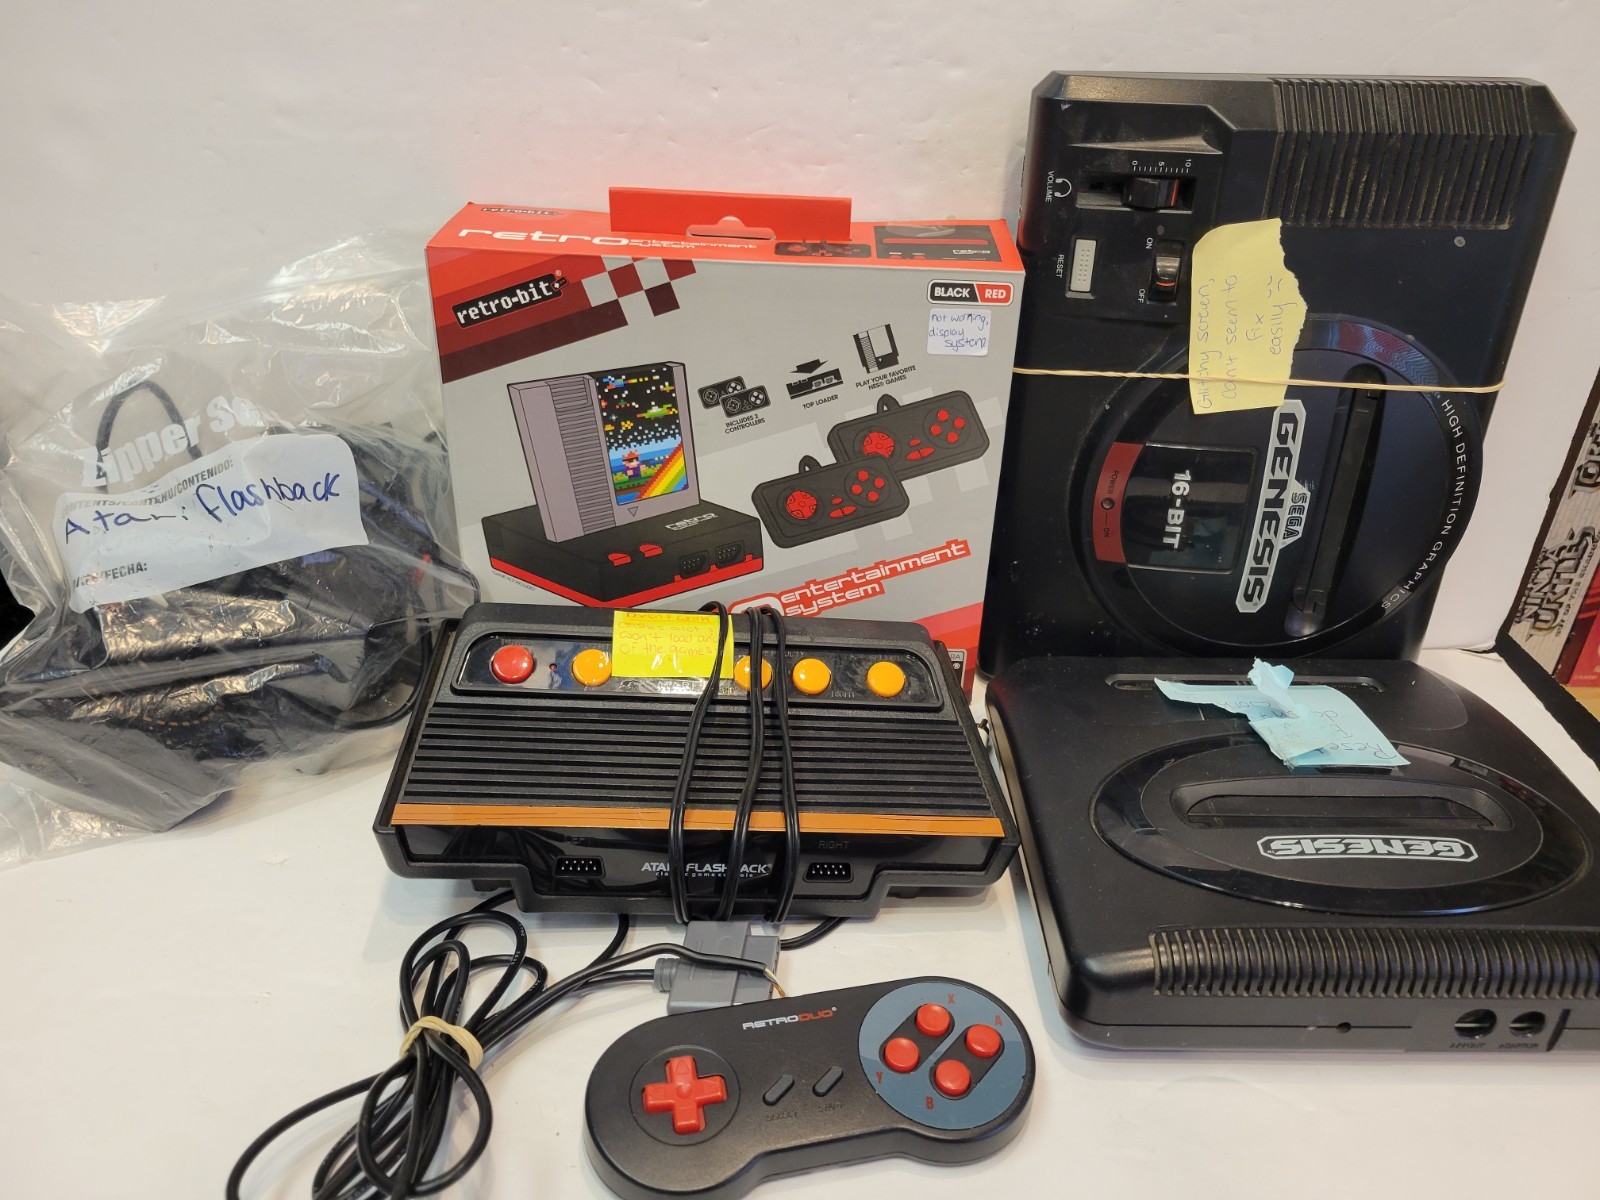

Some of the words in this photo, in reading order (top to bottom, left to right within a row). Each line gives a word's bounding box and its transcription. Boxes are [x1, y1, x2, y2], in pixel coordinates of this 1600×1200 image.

[1184, 158, 1192, 168] 10
[1045, 170, 1055, 203] VOLUME
[458, 228, 630, 247] retro
[1145, 237, 1154, 250] ON
[1055, 254, 1065, 279] RESET
[934, 286, 970, 298] BLACK
[984, 288, 1007, 299] RED
[1220, 274, 1238, 293] to
[456, 280, 553, 325] retro-bit
[1137, 288, 1146, 304] OFF
[931, 313, 947, 323] not
[1225, 299, 1238, 345] seem
[928, 326, 965, 339] display
[855, 378, 871, 388] PLAY
[871, 374, 888, 384] YOUR
[888, 365, 917, 379] FAVORITE
[885, 374, 907, 386] GAMES
[802, 402, 815, 410] TOP
[815, 394, 839, 407] LOADER
[725, 416, 754, 428] INCLUDES
[725, 417, 766, 434] CONTROLLERS
[1441, 399, 1464, 438] HIGH
[81, 415, 201, 489] Zipper
[1107, 469, 1120, 495] POWER
[1440, 442, 1467, 536] DEFINITION
[1162, 469, 1192, 549] 16-BIT
[1243, 412, 1299, 603] GENESIS
[1282, 492, 1308, 540] SEGA
[1103, 527, 1111, 538] ON
[780, 543, 966, 604] entertainment
[1381, 541, 1444, 610] GRAPHICS
[785, 582, 880, 616] system
[818, 840, 849, 849] RIGHT
[1269, 838, 1466, 857] GENESIS
[641, 862, 670, 872] ATA
[685, 863, 767, 873] FLASHACK
[948, 994, 955, 1004] X
[995, 1015, 1003, 1026] A
[875, 1072, 883, 1084] Y
[926, 1096, 934, 1109] B
